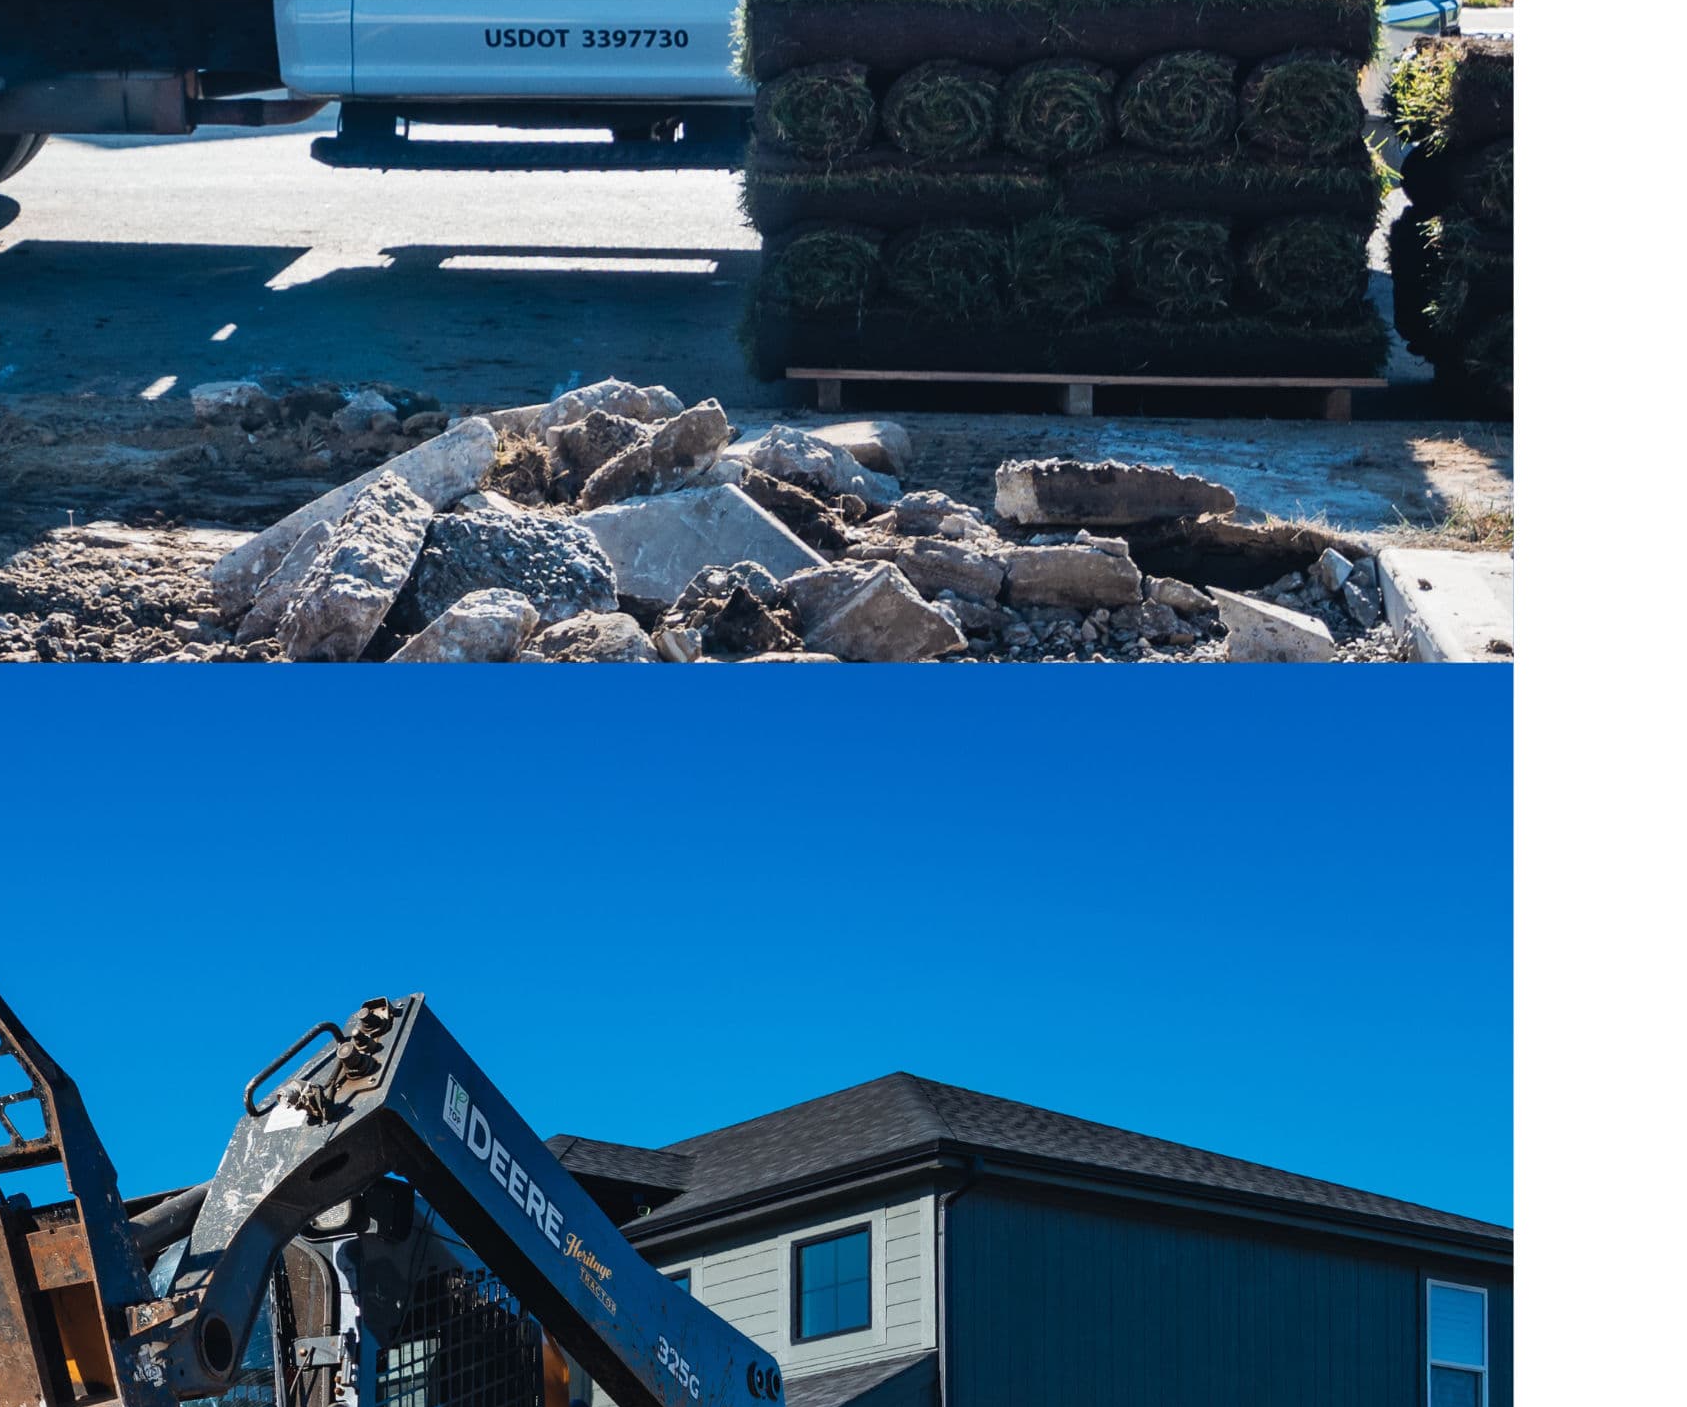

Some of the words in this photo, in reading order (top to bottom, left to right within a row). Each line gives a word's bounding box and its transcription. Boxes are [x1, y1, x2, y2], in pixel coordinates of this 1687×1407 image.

[484, 28, 570, 48] USDOT
[582, 29, 689, 48] 3397730
[467, 1104, 564, 1249] DEERE
[563, 1233, 612, 1281] Heritage
[579, 1266, 617, 1316] TRACTOR
[657, 1335, 700, 1400] 325G
